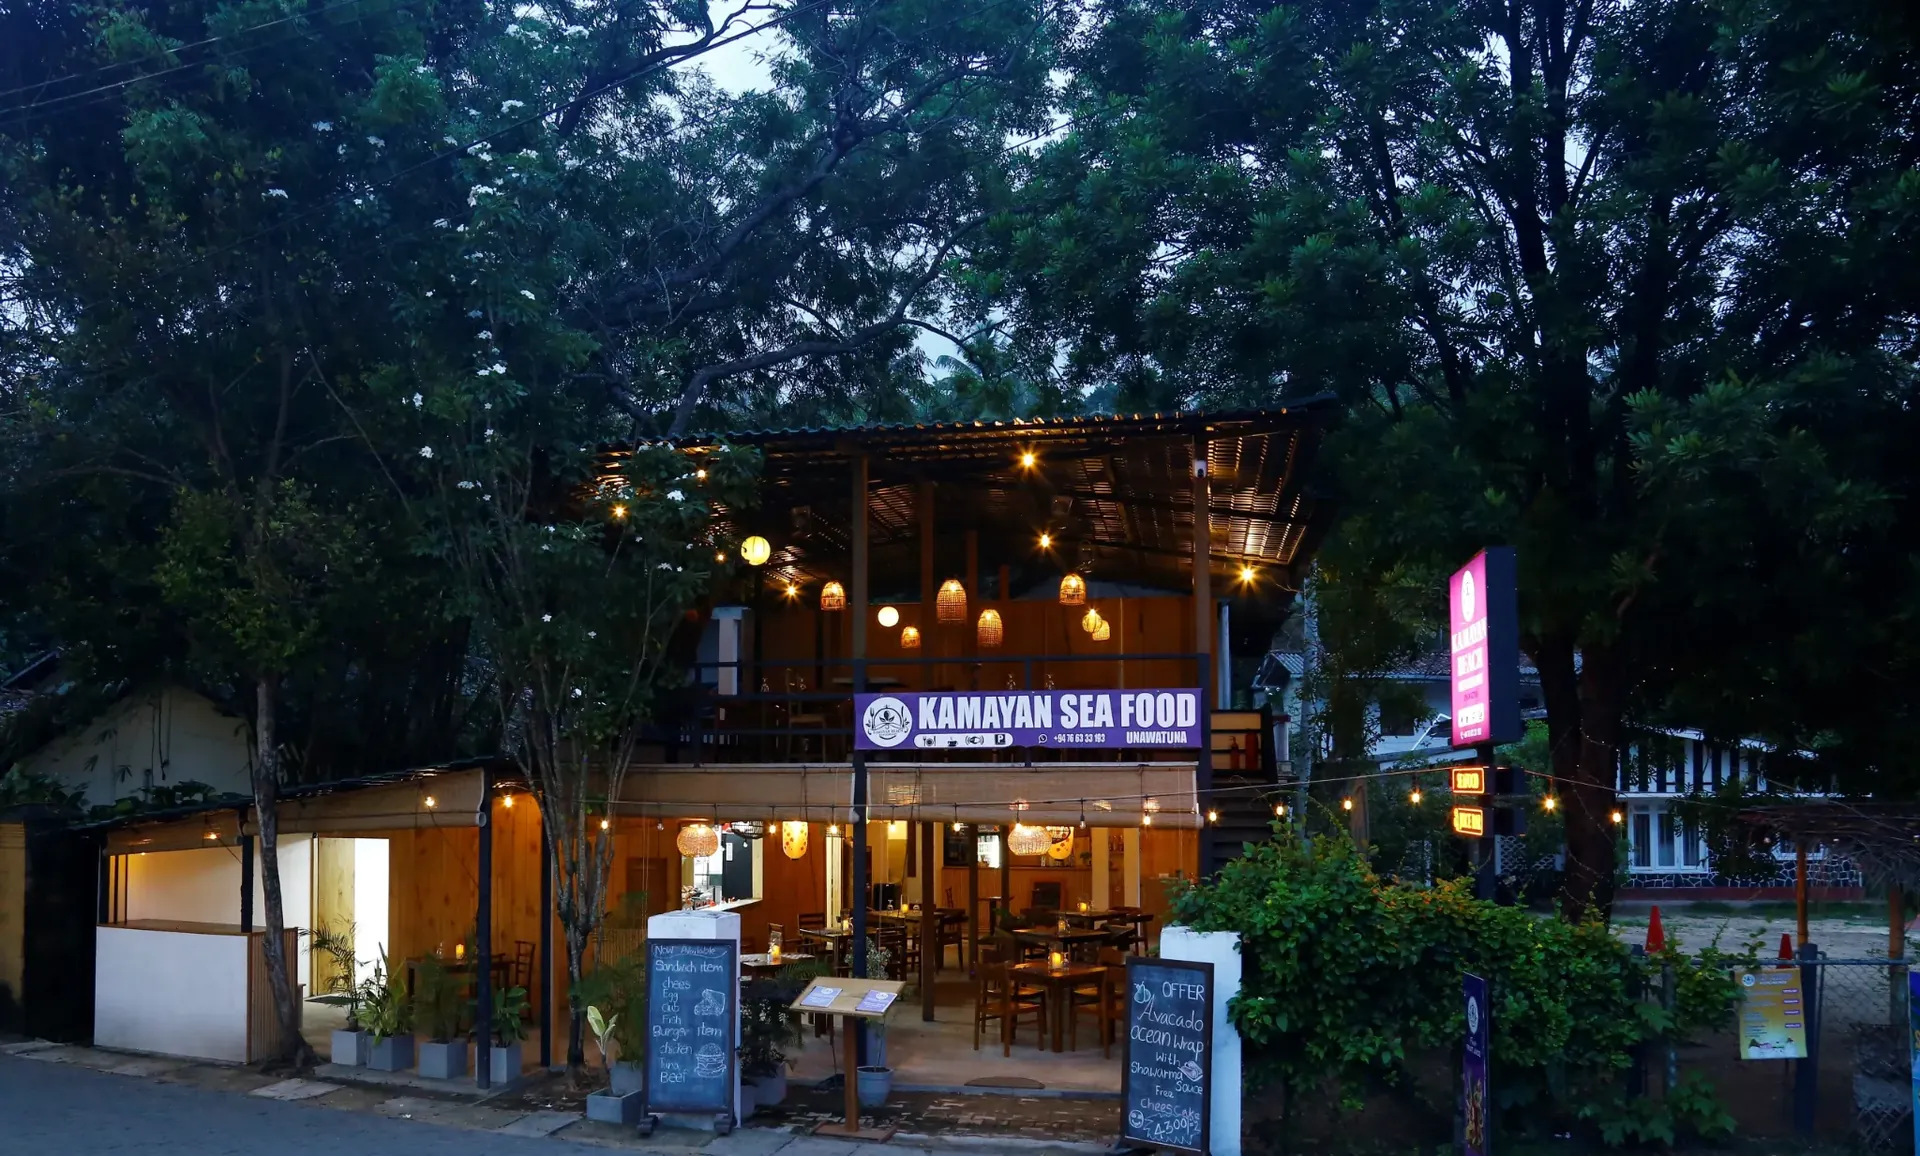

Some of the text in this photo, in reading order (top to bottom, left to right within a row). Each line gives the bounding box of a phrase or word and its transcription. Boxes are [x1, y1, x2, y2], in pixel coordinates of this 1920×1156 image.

[918, 692, 1196, 730] KAMAYAN SEA FOOD
[1066, 733, 1074, 743] 76
[1075, 733, 1084, 743] 63
[1126, 731, 1188, 744] UNAWATUNA
[655, 959, 697, 973] Sandwich
[662, 988, 679, 1003] Egg
[1162, 981, 1205, 1002] OFFER
[662, 1013, 682, 1025] Fish
[1136, 993, 1204, 1032] Avacado
[652, 1024, 690, 1042] Burger
[659, 1057, 680, 1070] Tuna
[1130, 1060, 1184, 1081] Shawarma
[660, 1068, 689, 1084] Beef
[1155, 1084, 1175, 1099] Free
[1175, 1080, 1204, 1095] Sauce
